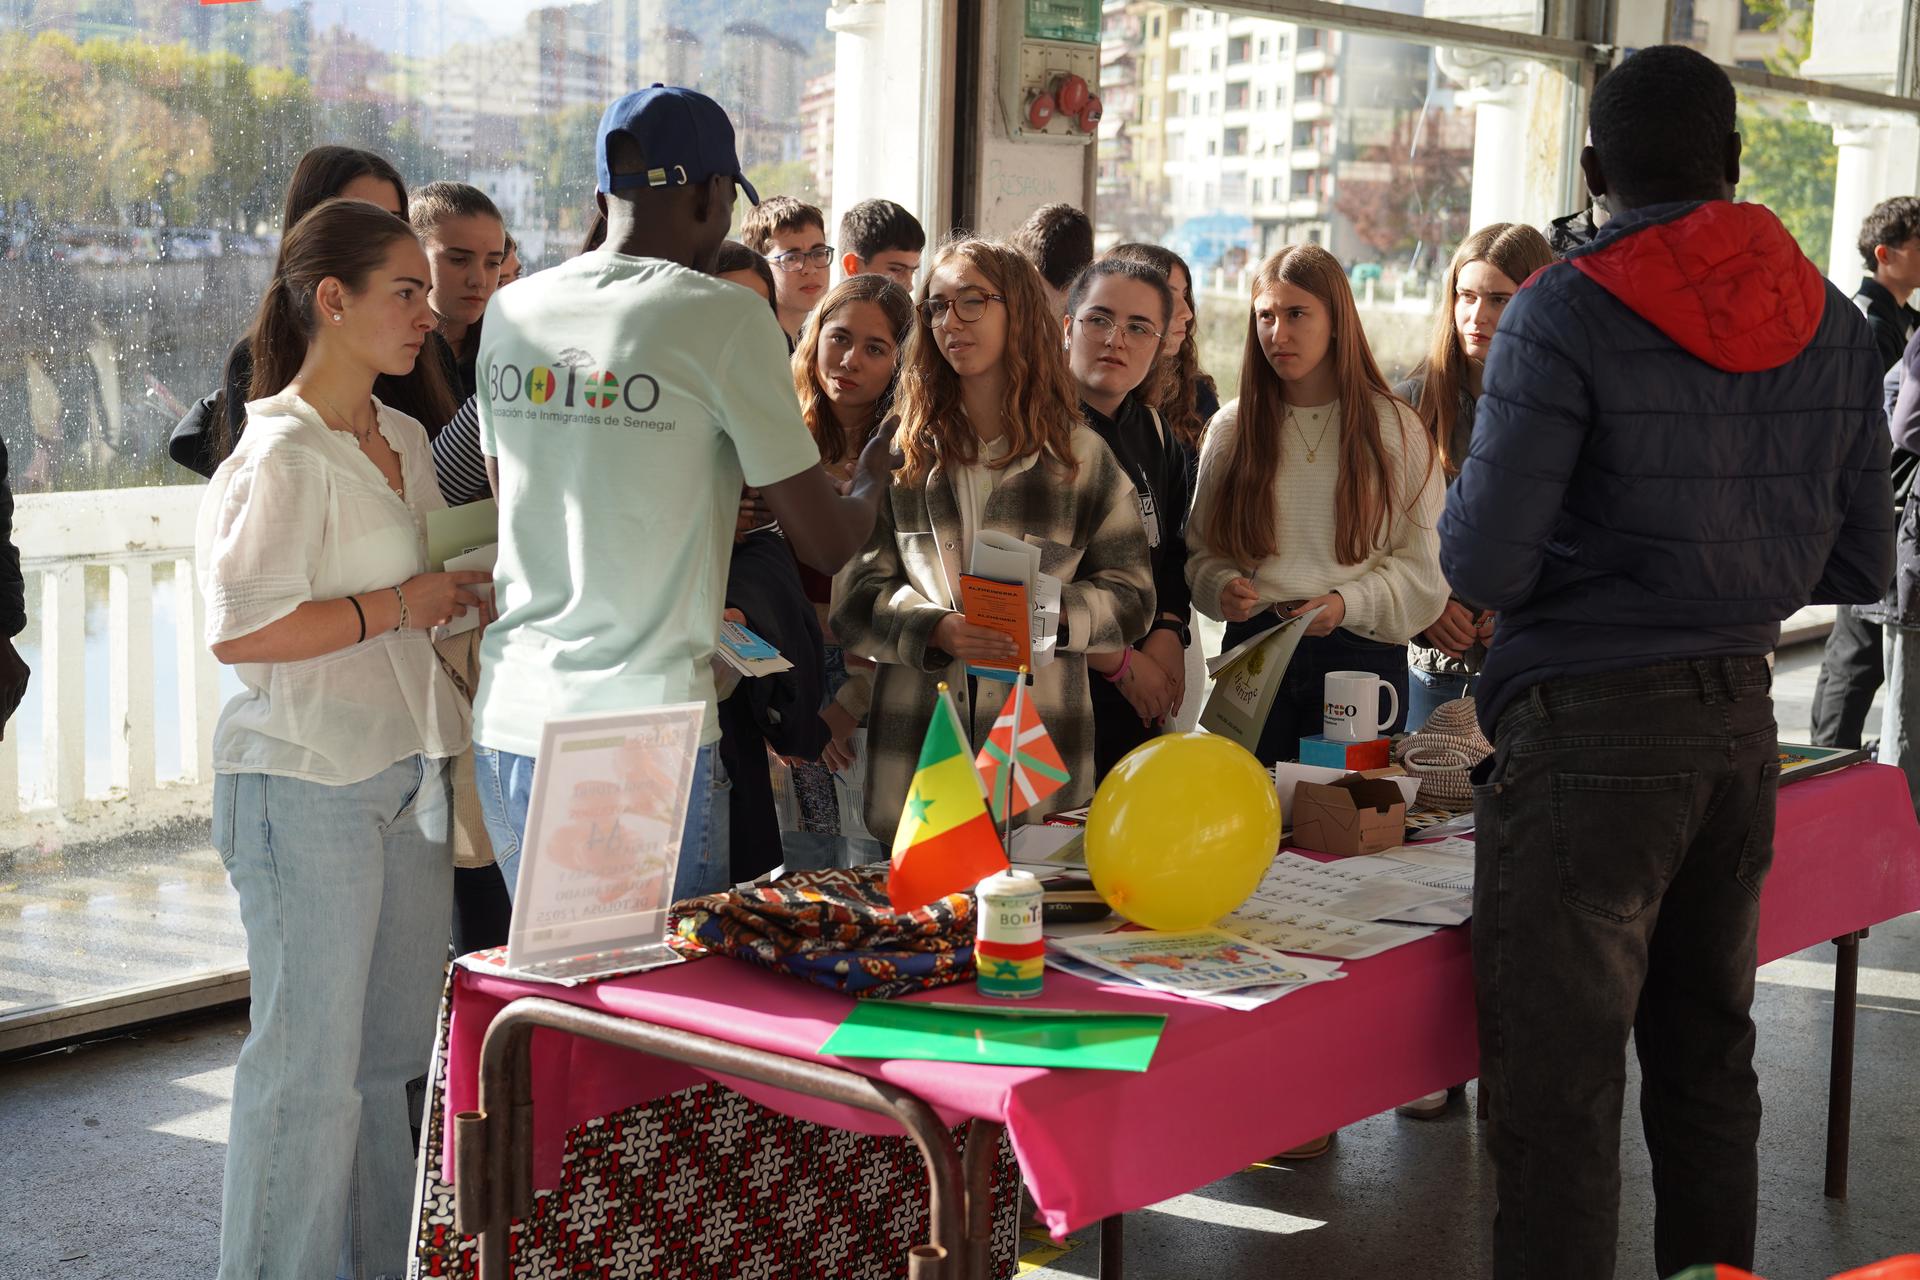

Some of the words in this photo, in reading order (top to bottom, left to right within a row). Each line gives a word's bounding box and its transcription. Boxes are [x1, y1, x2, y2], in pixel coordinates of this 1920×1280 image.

[539, 410, 601, 425] Inmigrantes
[603, 415, 620, 426] de
[622, 416, 676, 432] Senegal
